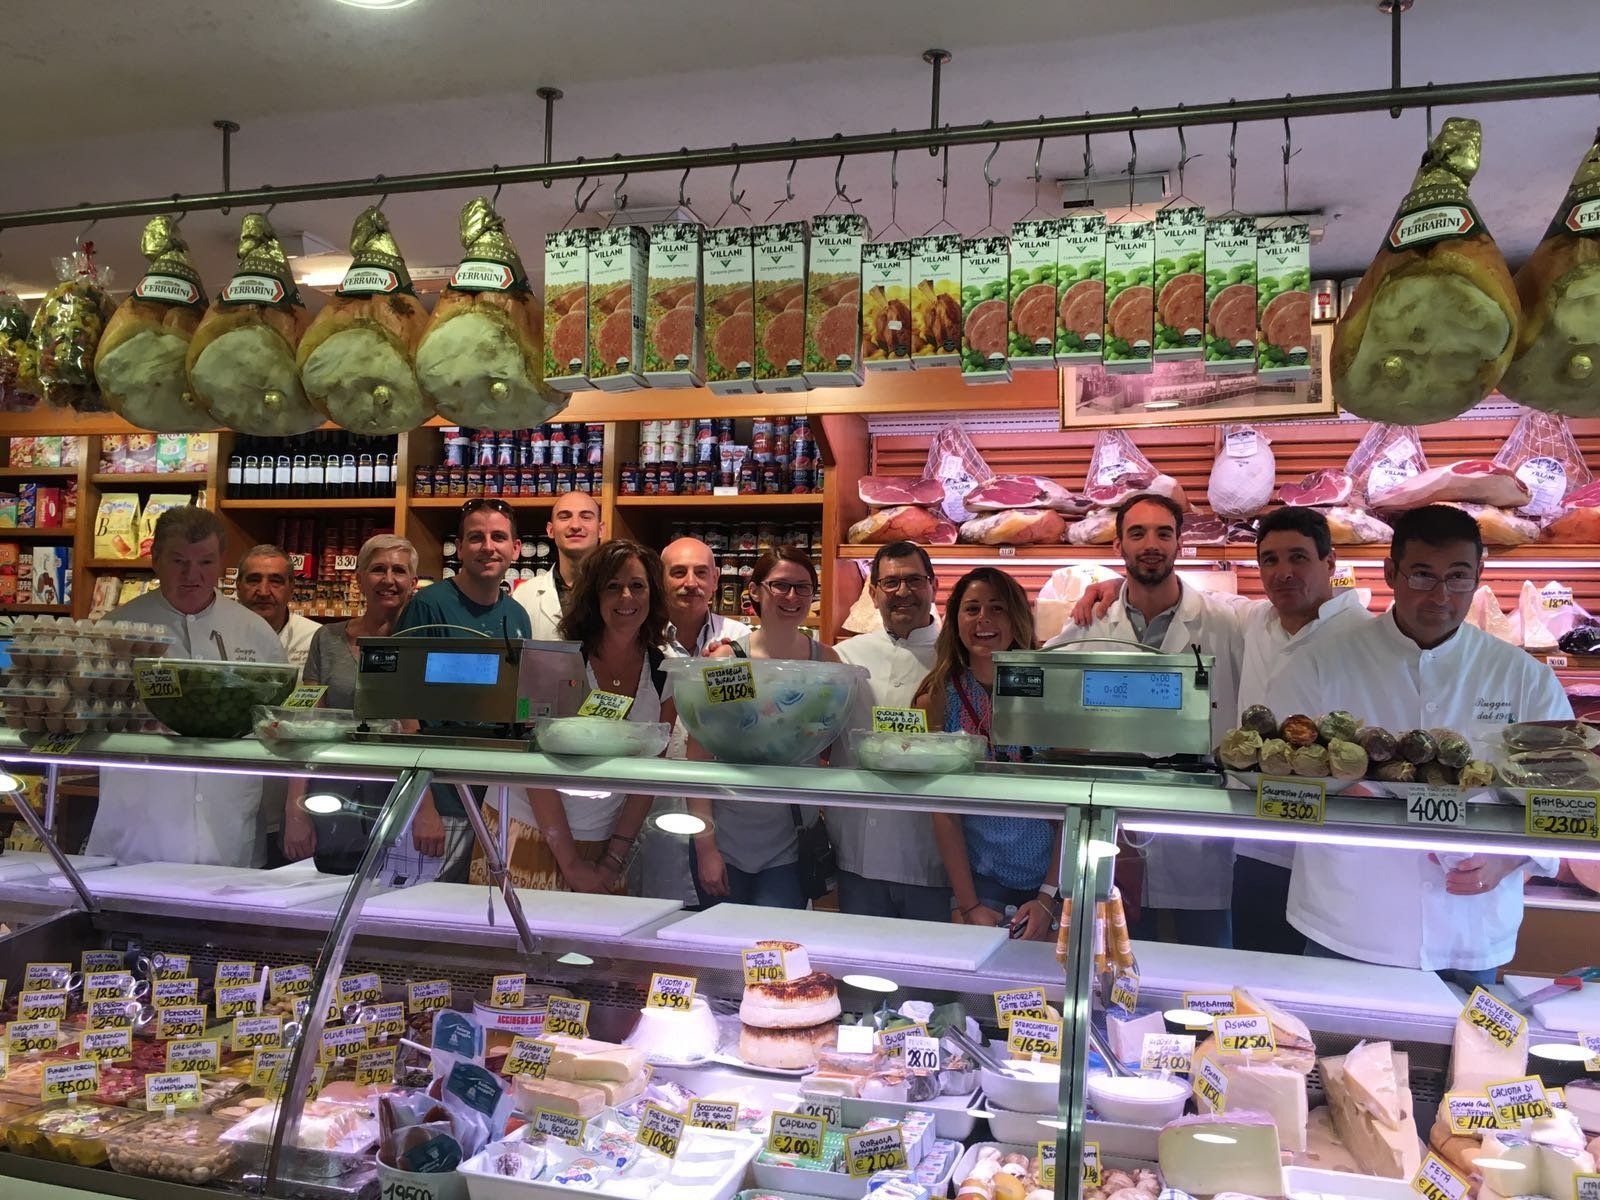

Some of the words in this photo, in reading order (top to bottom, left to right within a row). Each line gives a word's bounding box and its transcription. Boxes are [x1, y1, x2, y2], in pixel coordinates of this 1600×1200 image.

[1163, 228, 1197, 237] VILLANI
[1400, 217, 1461, 239] FERRARINI
[818, 238, 851, 246] VILLANI
[1066, 236, 1098, 244] VILLANI
[1214, 239, 1248, 248] VILLANI
[657, 244, 688, 252] VILLANI
[761, 245, 793, 254] VILLANI
[1018, 241, 1050, 249] VILLANI
[1114, 242, 1147, 250] VILLANI
[551, 250, 578, 259] VILLANI
[595, 248, 622, 258] VILLANI
[710, 248, 742, 258] VILLANI
[1265, 246, 1300, 255] VILLANI
[921, 255, 950, 263] VILLANI
[969, 257, 999, 265] VILLANI
[872, 261, 900, 269] VILLANI
[457, 272, 503, 283] FERRARINI
[344, 276, 388, 291] FERRARINI
[143, 284, 190, 297] FERRARINI
[229, 285, 274, 297] FERRARINI
[1477, 712, 1492, 720] dal
[1533, 797, 1596, 809] GAMBUCCIO
[164, 1008, 201, 1017] POMODORI
[1478, 995, 1514, 1022] GRUYERE
[1225, 1020, 1257, 1031] ASIAGO
[1510, 1093, 1533, 1102] MUCCA
[780, 1117, 816, 1129] CAPRINO
[860, 1135, 893, 1147] ROBIOLA
[1430, 1162, 1451, 1183] FETA
